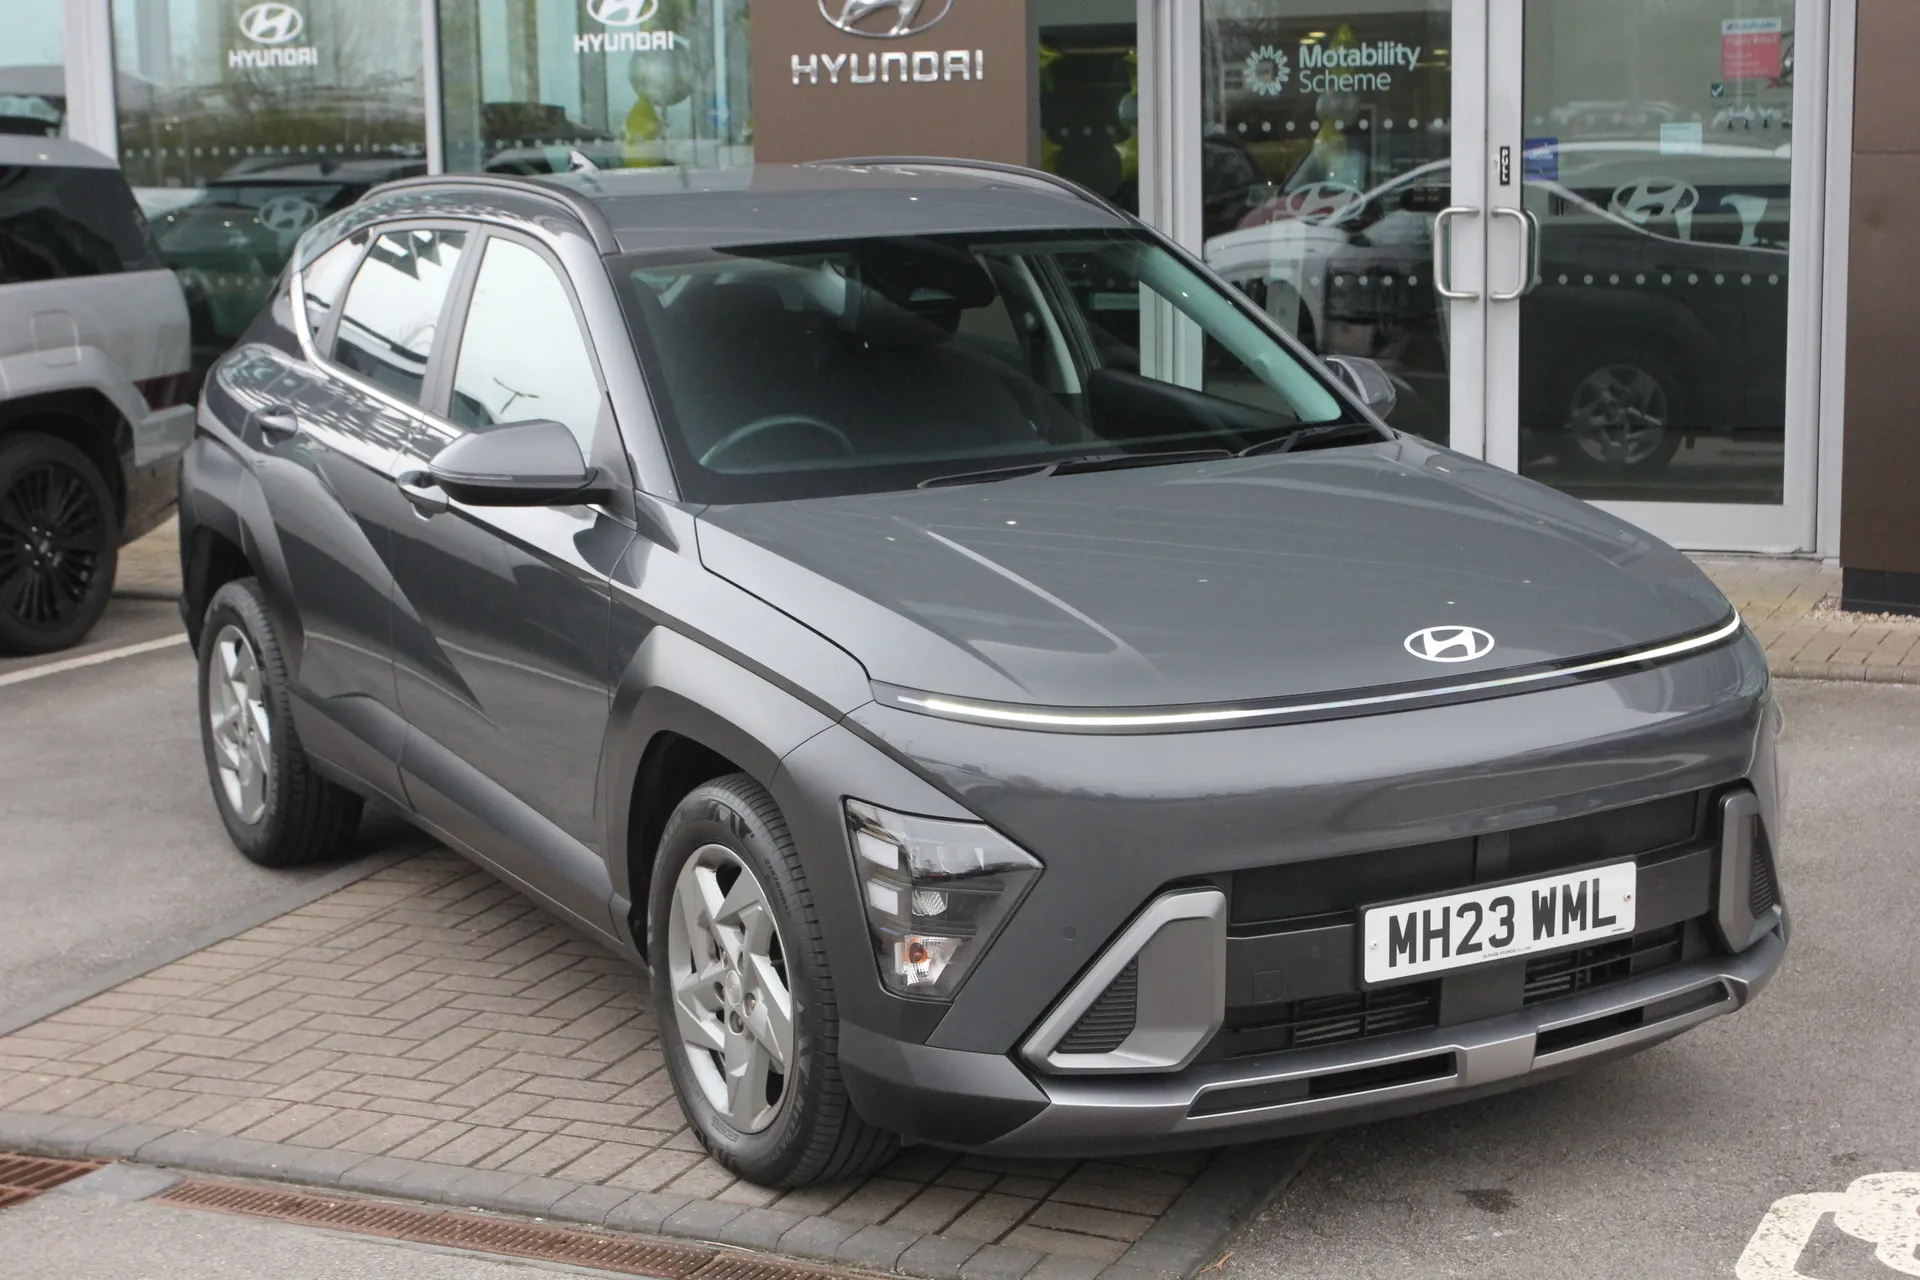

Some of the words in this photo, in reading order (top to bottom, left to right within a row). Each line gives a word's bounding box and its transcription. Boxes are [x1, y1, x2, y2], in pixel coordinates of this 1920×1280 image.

[228, 46, 318, 68] HYUNDAI
[573, 30, 675, 53] HYUNDAI
[1299, 41, 1421, 72] Motability
[791, 49, 984, 85] HYUNDAI
[1299, 70, 1391, 93] Scheme
[1501, 148, 1509, 182] PULL
[1389, 895, 1515, 967] MH23
[1531, 878, 1616, 940] WML
